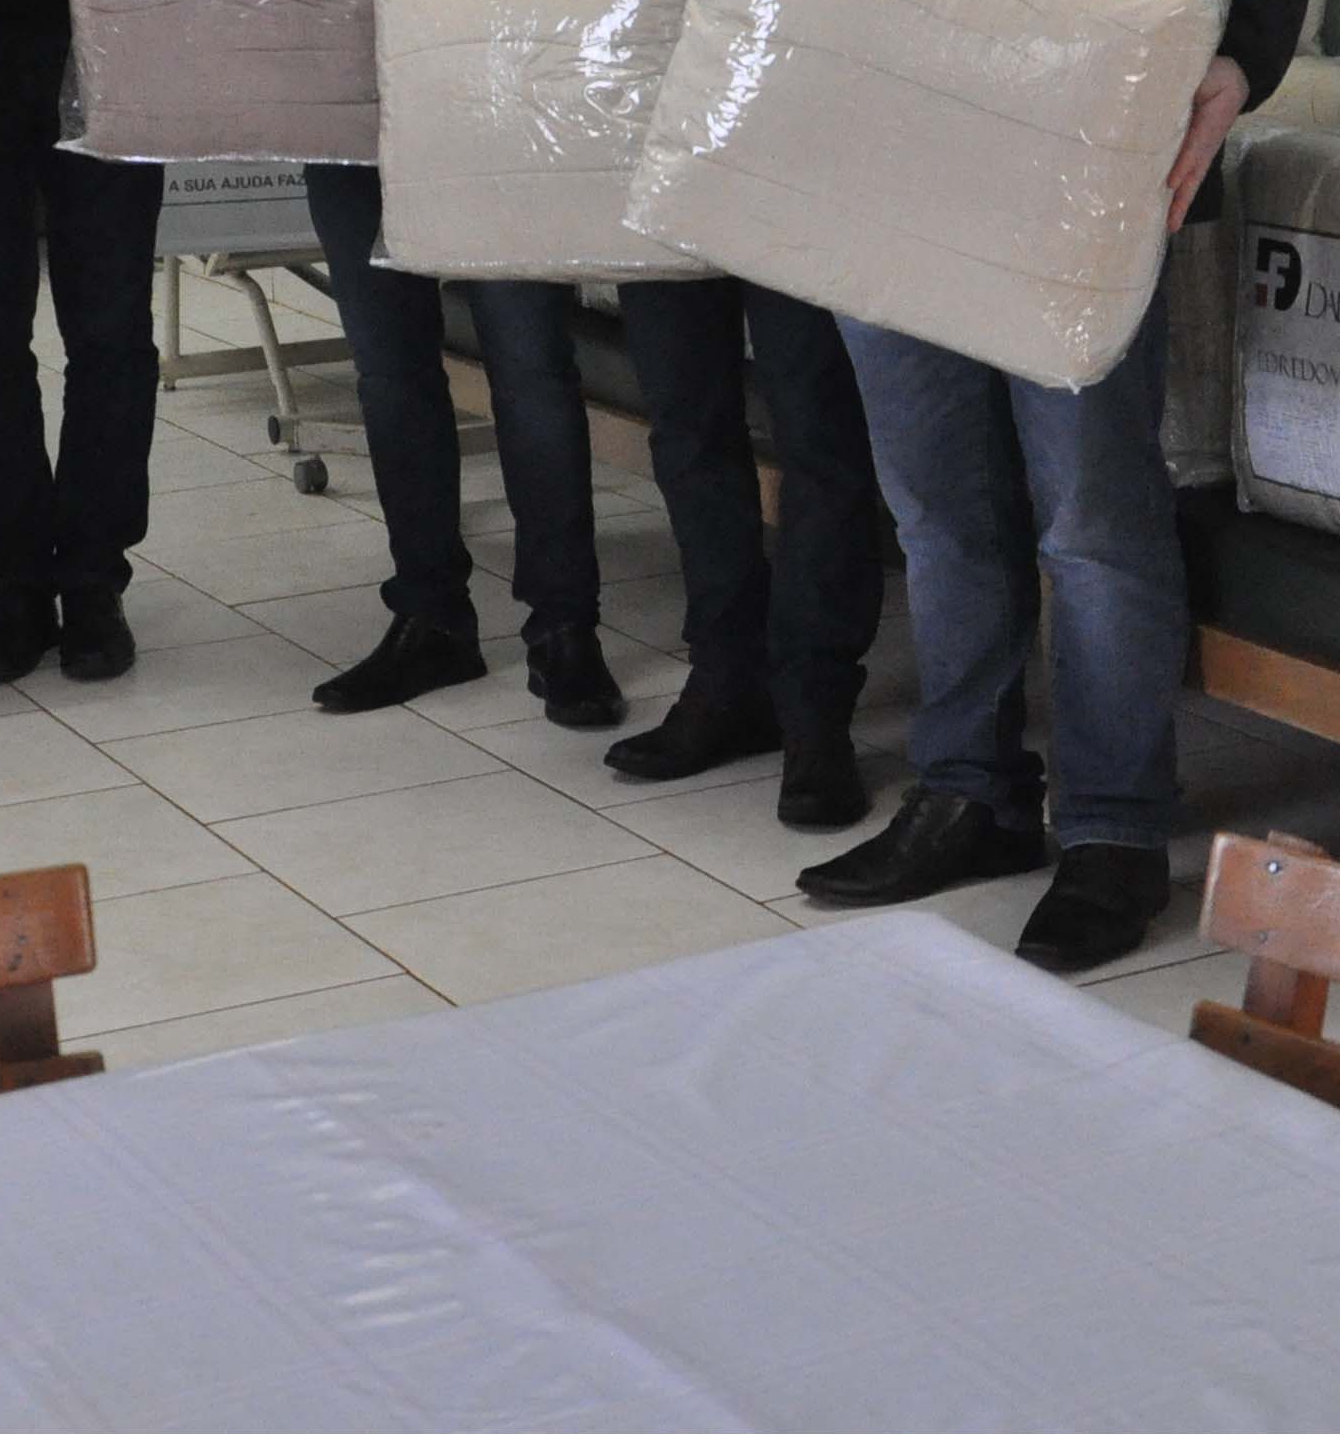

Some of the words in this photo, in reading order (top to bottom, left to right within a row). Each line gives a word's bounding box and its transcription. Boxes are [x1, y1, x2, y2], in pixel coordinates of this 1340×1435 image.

[168, 179, 180, 193] A
[184, 177, 217, 192] SUA
[221, 175, 274, 190] AJUDA
[277, 173, 307, 187] FAZ
